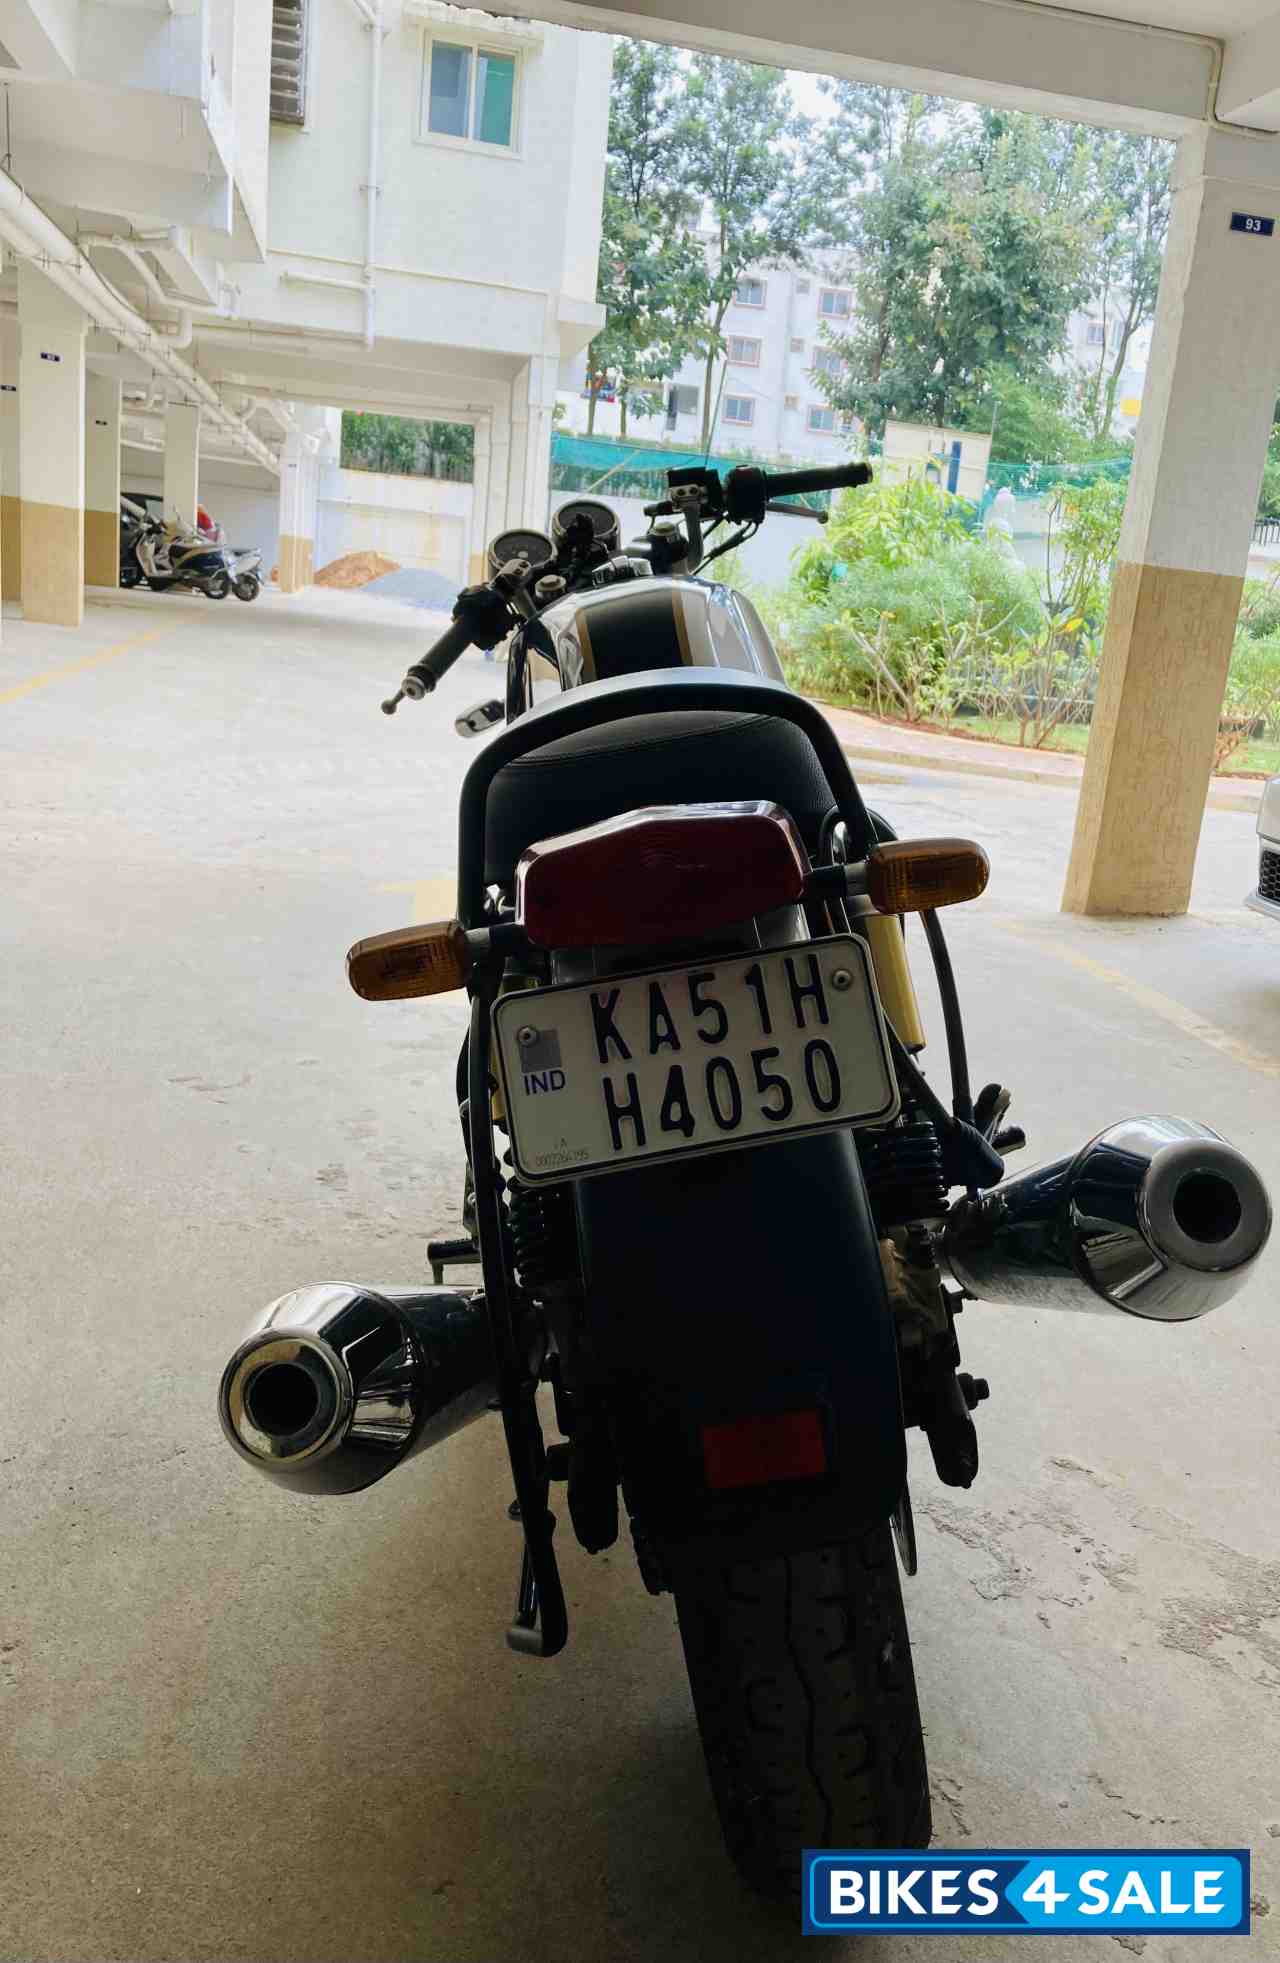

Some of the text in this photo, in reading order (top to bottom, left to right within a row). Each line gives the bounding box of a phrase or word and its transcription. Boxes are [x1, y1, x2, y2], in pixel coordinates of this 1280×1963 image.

[1246, 218, 1262, 231] 93
[590, 954, 830, 1064] KA51H
[523, 1069, 566, 1096] IND
[603, 1039, 841, 1150] H4050
